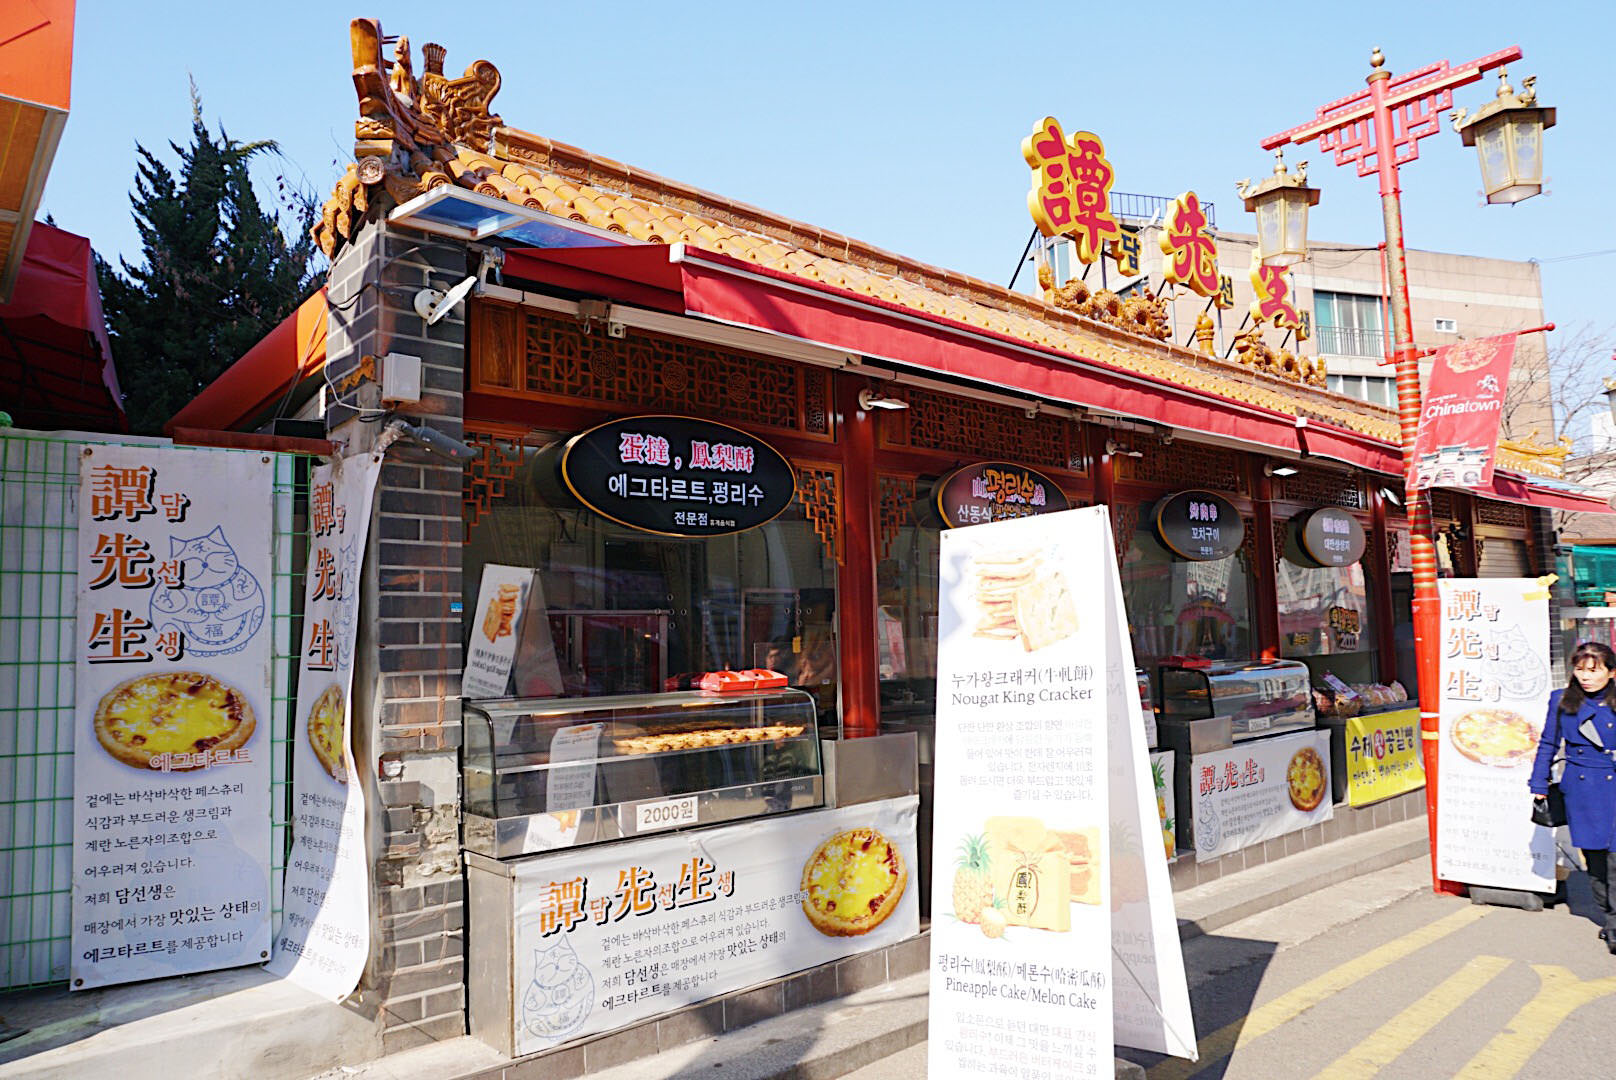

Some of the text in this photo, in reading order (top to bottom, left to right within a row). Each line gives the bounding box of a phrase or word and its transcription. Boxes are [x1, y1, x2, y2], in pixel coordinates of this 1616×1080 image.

[1426, 399, 1500, 419] Chinatown
[674, 511, 708, 526] 전문점
[952, 686, 1094, 708] Nougat King Cracker
[150, 749, 253, 773] 에그타르트
[86, 782, 245, 809] 겉에는 바삭바삭한 페스츄리
[85, 806, 233, 831] 식감과 부드러운 생크림과
[643, 801, 694, 825] 2000원
[85, 838, 112, 853] 계란
[84, 857, 196, 878] 어우러져 있습니다.
[84, 884, 177, 906] 저희 담선생은
[84, 900, 262, 935] 매장에서 가장 맛있는 상태의
[601, 890, 810, 951] 겉에는 바삭바삭한 페스츄리 식감과 부드러운 생크림과
[83, 930, 244, 963] 에크타르트를 제공합니다
[601, 954, 622, 970] 계란
[699, 928, 735, 945] 어우러져
[601, 930, 787, 988] 저희 담선생은 매장에서 가장 맛있는 상태의
[672, 969, 719, 991] 제공합니다
[945, 977, 1097, 1010] Pineapple Cake/Melon Cake
